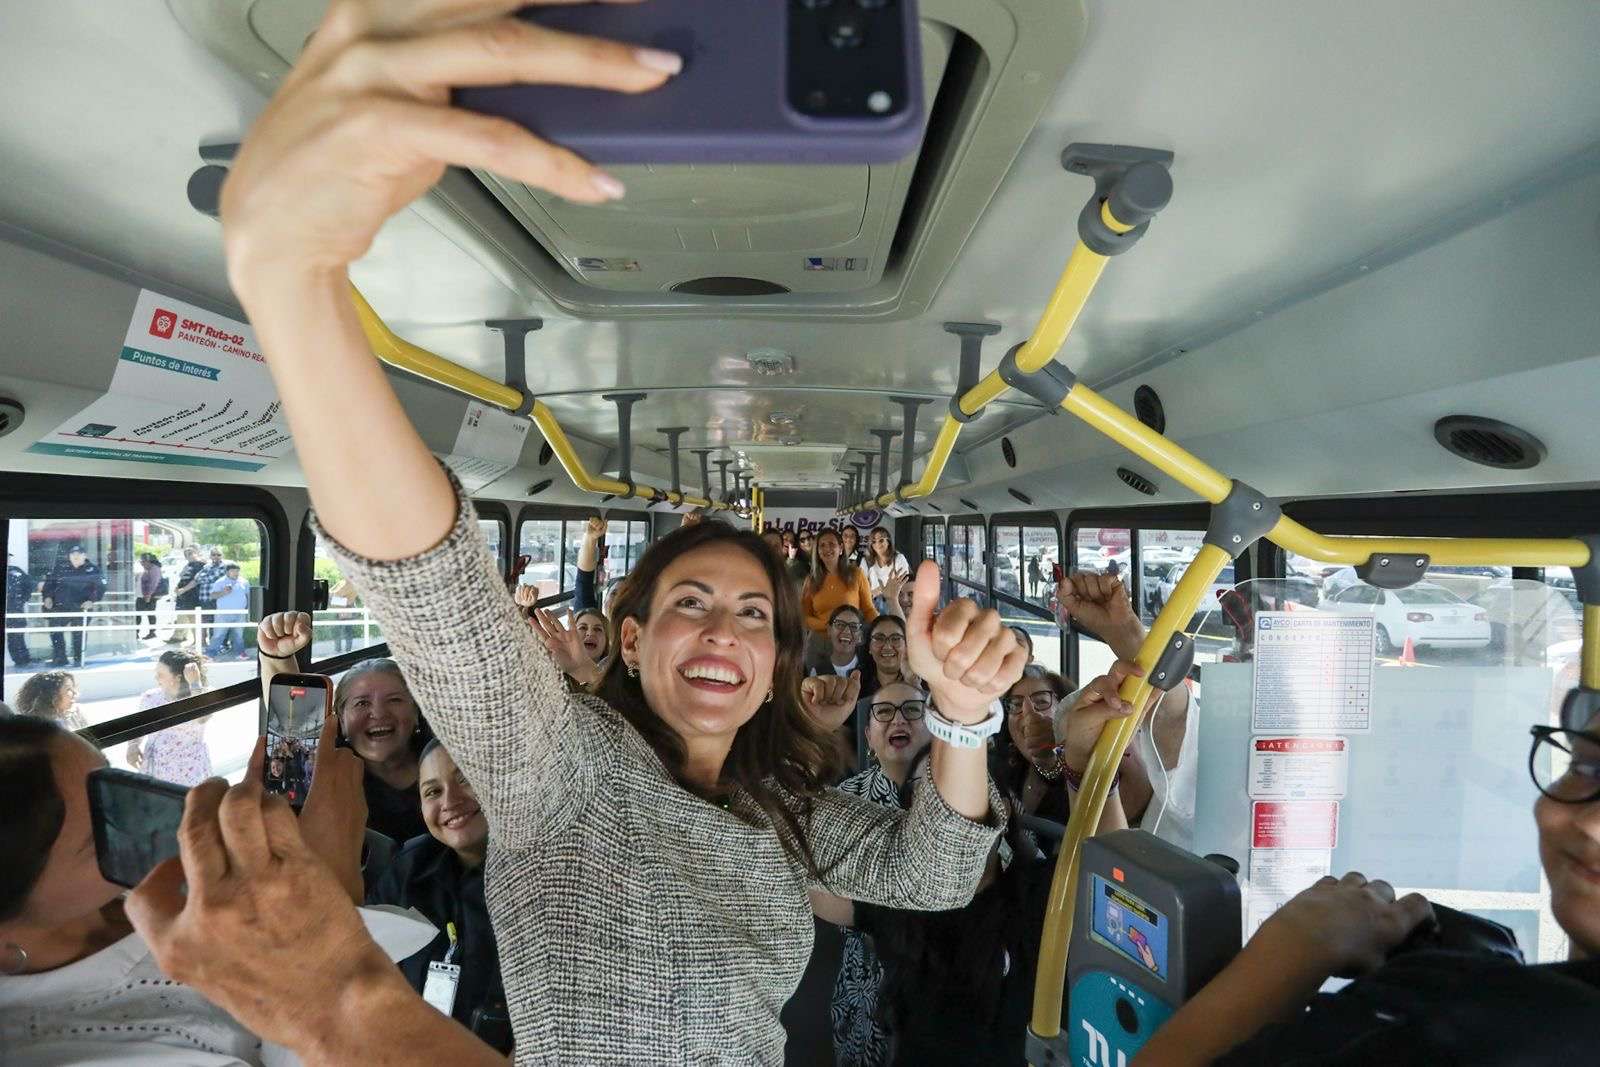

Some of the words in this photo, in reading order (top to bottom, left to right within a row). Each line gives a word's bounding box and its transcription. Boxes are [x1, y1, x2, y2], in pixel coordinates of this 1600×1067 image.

[180, 319, 206, 334] SMT
[205, 326, 245, 346] Ruta-02
[222, 344, 251, 359] CAMINO
[132, 351, 167, 368] Puntos
[168, 358, 181, 371] de
[182, 362, 212, 378] interés
[775, 517, 795, 531] La
[798, 517, 826, 532] Paz
